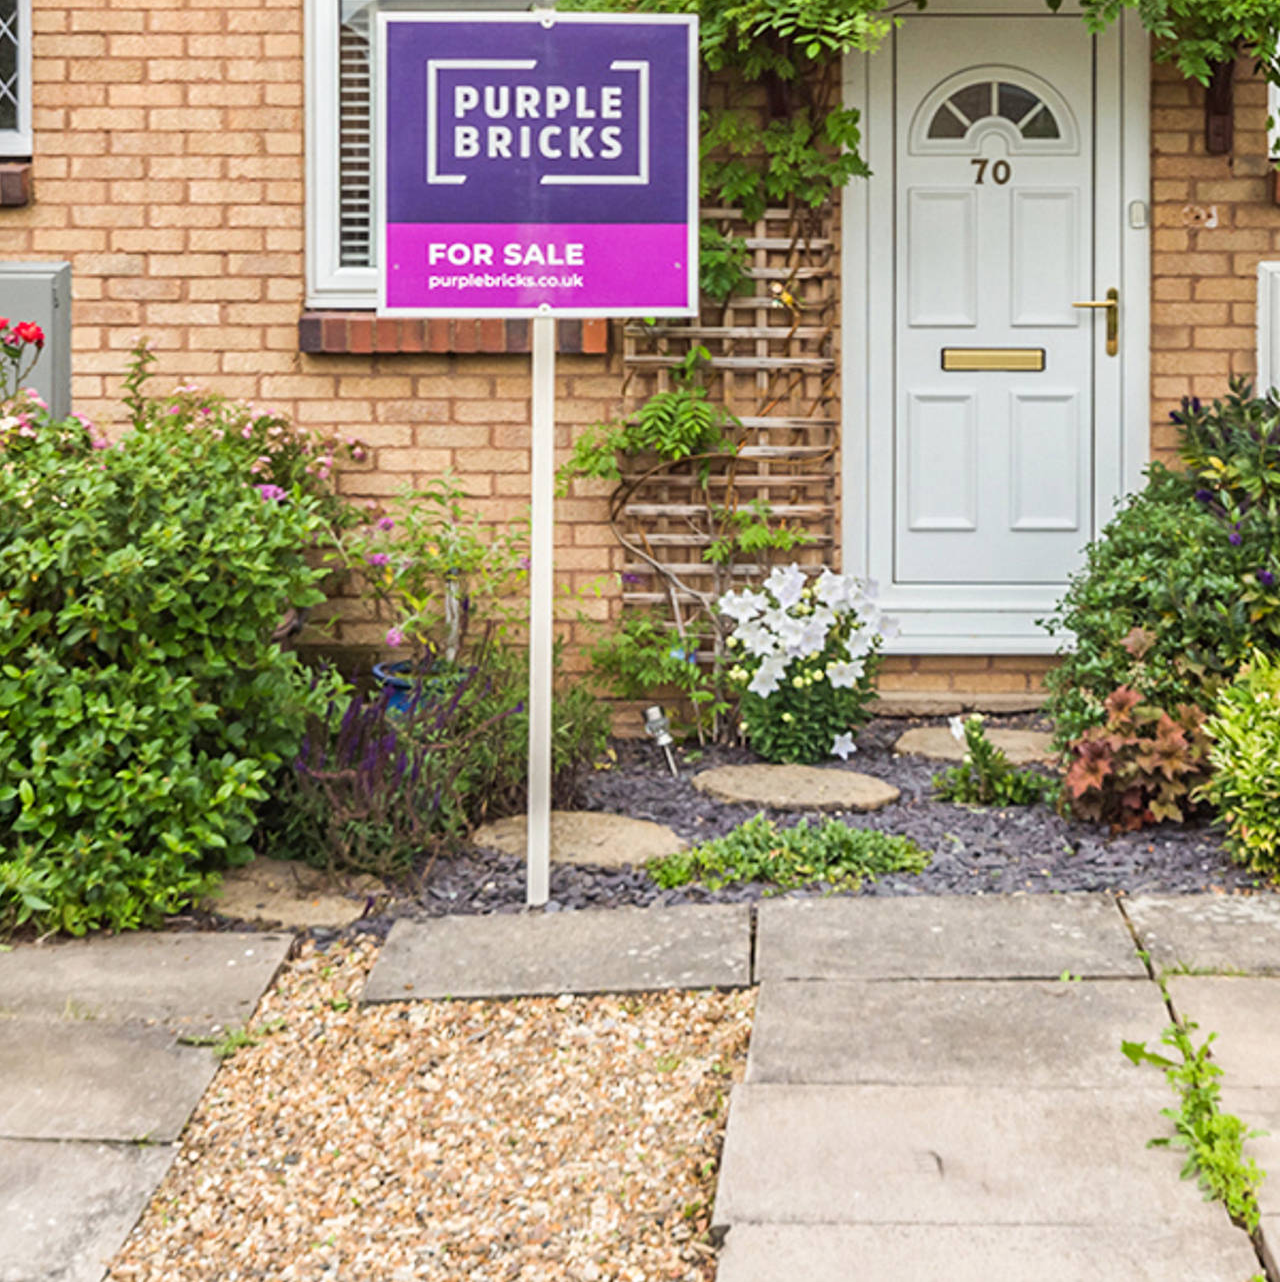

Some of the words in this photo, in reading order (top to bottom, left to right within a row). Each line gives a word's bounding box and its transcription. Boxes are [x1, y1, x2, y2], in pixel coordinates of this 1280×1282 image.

[453, 85, 623, 119] PURPLE
[453, 125, 623, 160] BRICKS
[970, 158, 1012, 185] 70
[428, 242, 494, 266] FOR
[503, 242, 585, 266] SALE
[428, 273, 584, 290] purplebricks.co.uk
